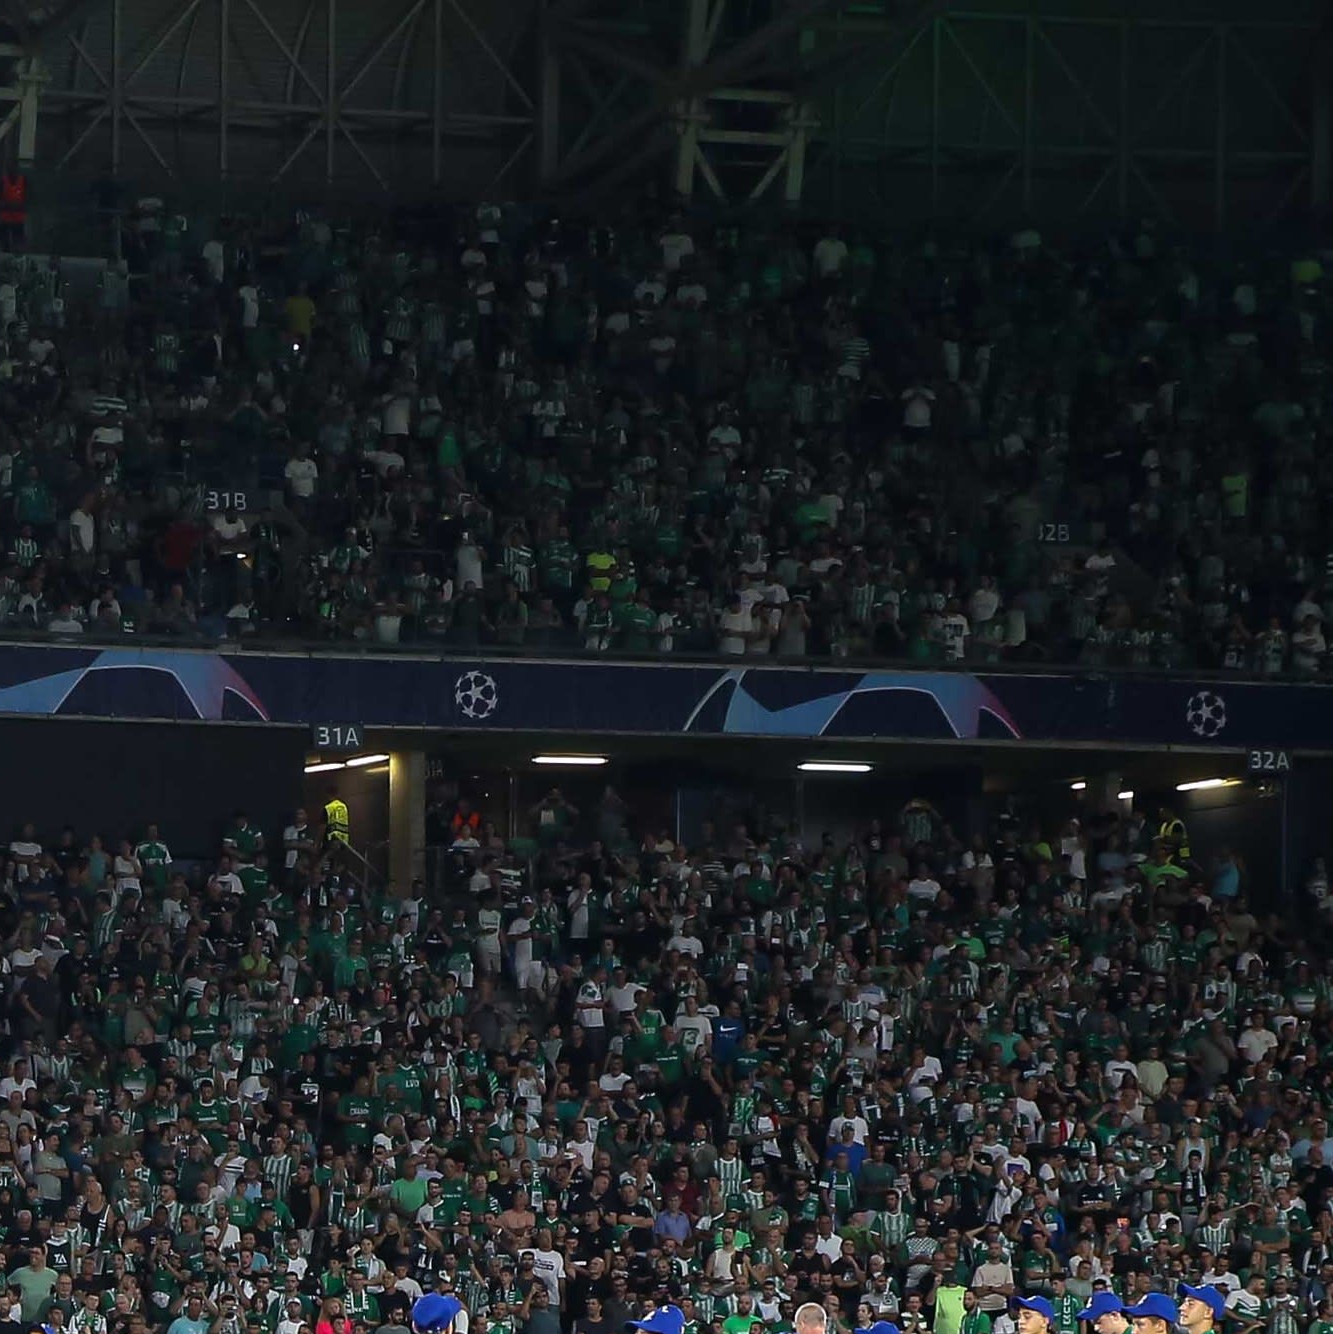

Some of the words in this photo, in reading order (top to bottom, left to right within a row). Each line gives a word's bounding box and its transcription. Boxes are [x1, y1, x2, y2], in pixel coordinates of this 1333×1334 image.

[207, 491, 247, 511] 31B
[317, 726, 360, 746] 31A
[1251, 750, 1290, 770] 32A
